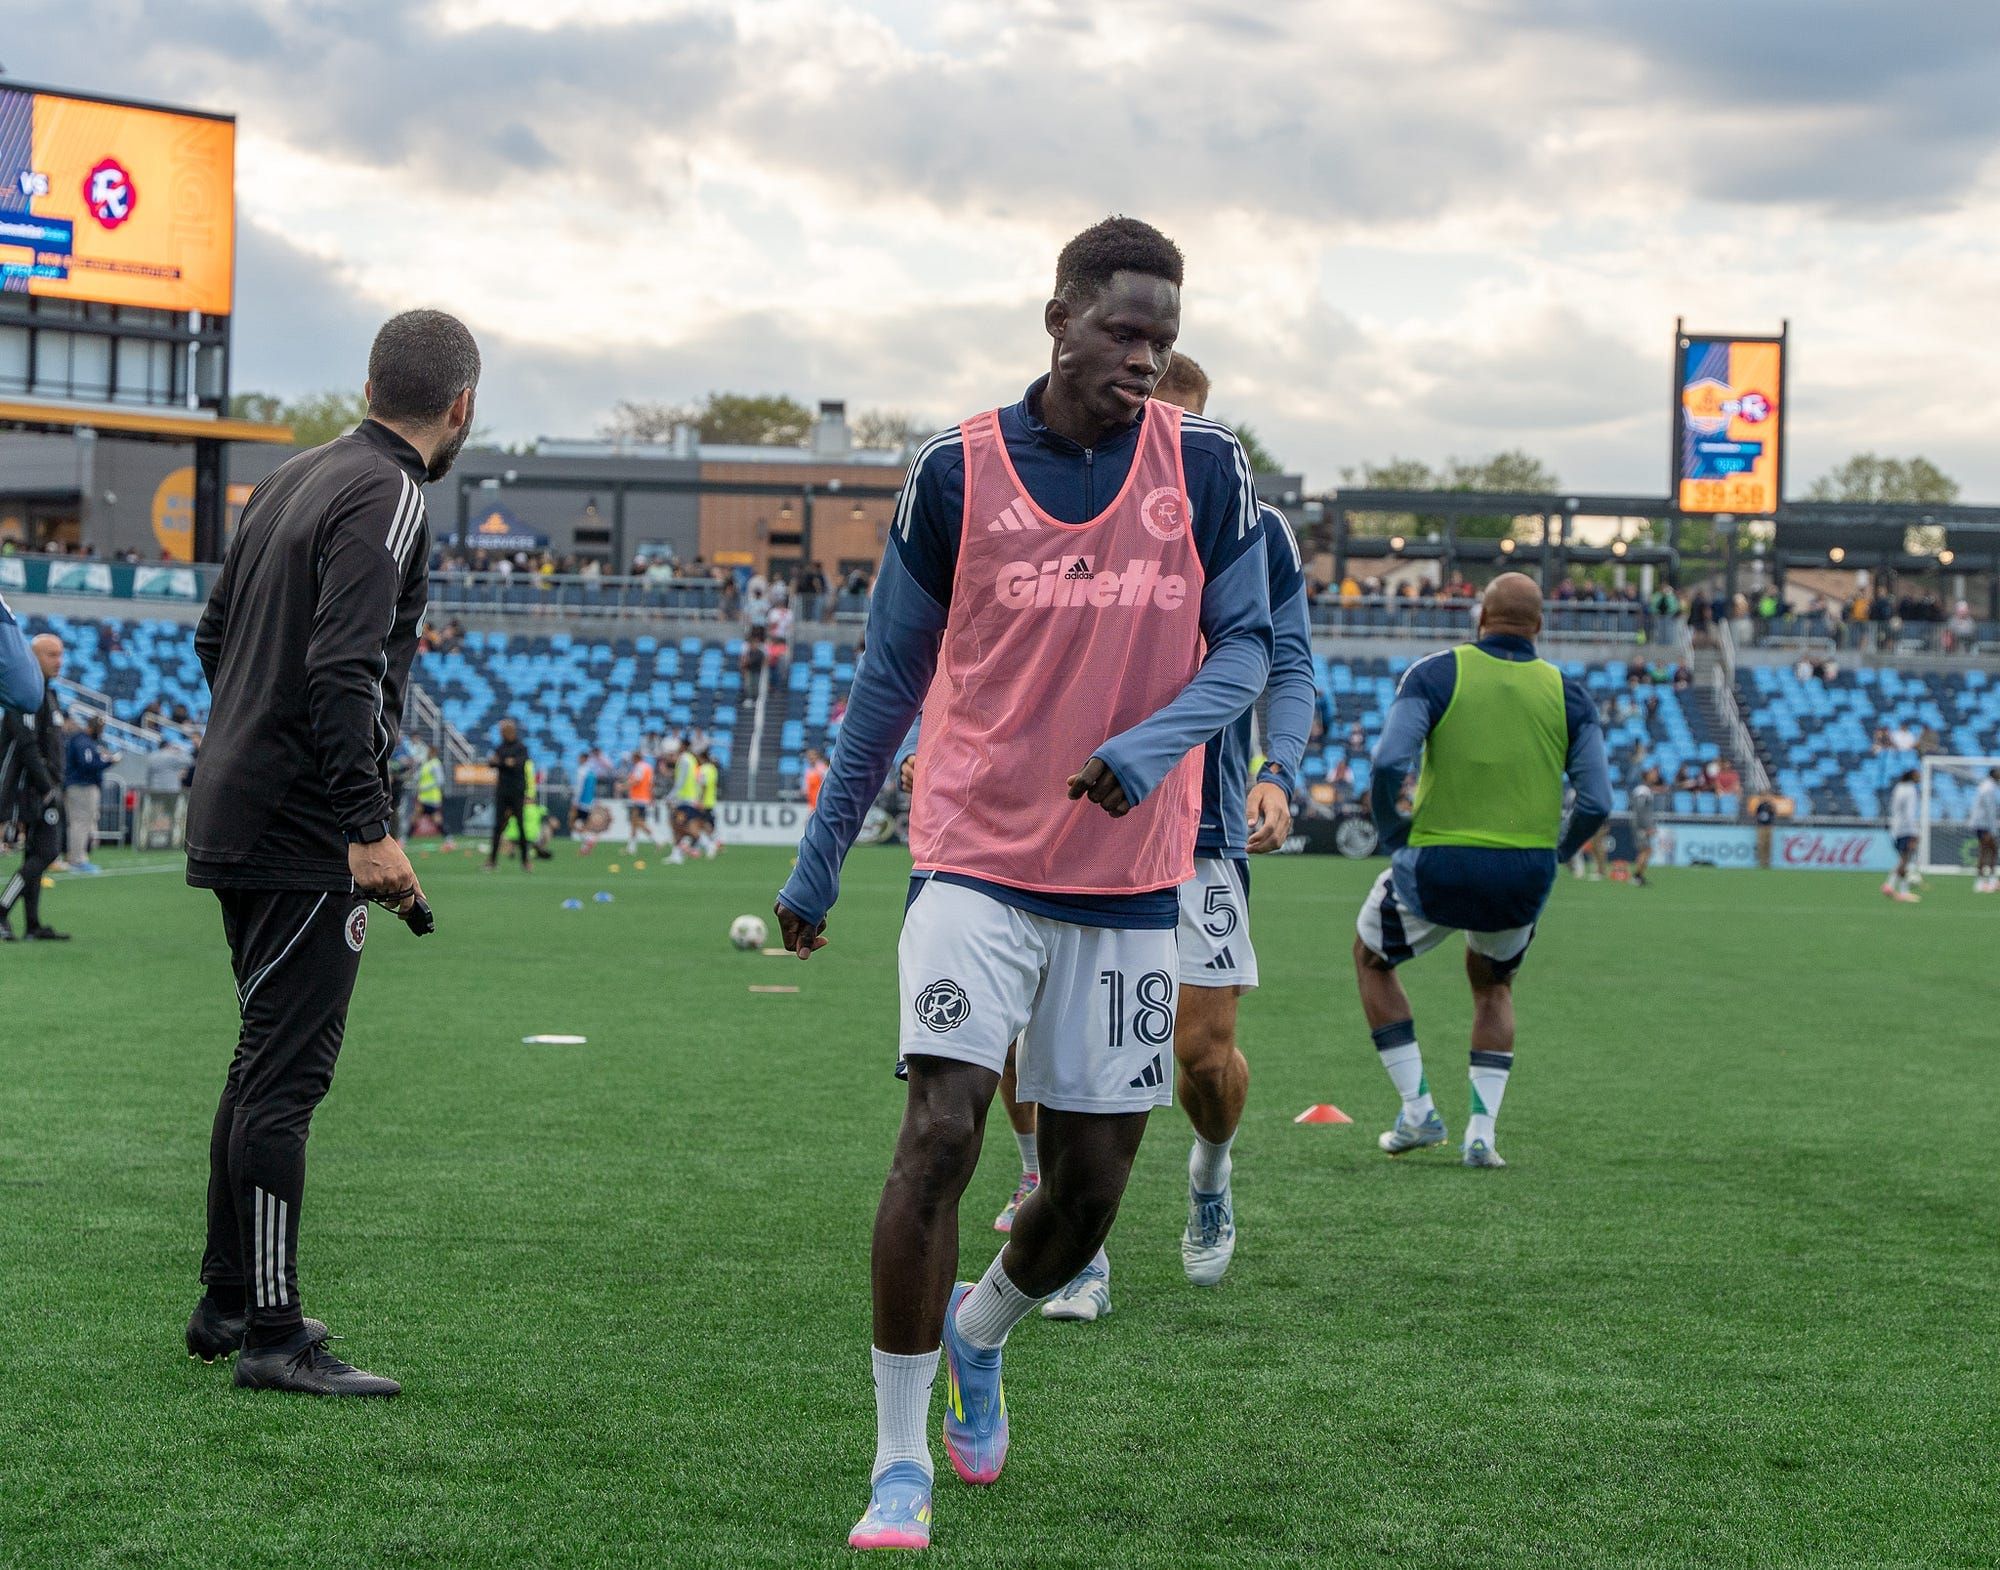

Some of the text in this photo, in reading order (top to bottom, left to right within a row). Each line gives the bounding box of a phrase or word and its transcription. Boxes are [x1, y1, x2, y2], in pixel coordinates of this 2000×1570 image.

[19, 171, 49, 196] VS
[995, 555, 1186, 611] Gillette
[1064, 571, 1094, 580] adidas
[724, 806, 798, 827] UILD
[1685, 840, 1757, 861] CHOO
[1783, 831, 1872, 866] Chill
[1203, 885, 1237, 938] 5
[1101, 969, 1174, 1047] 18
